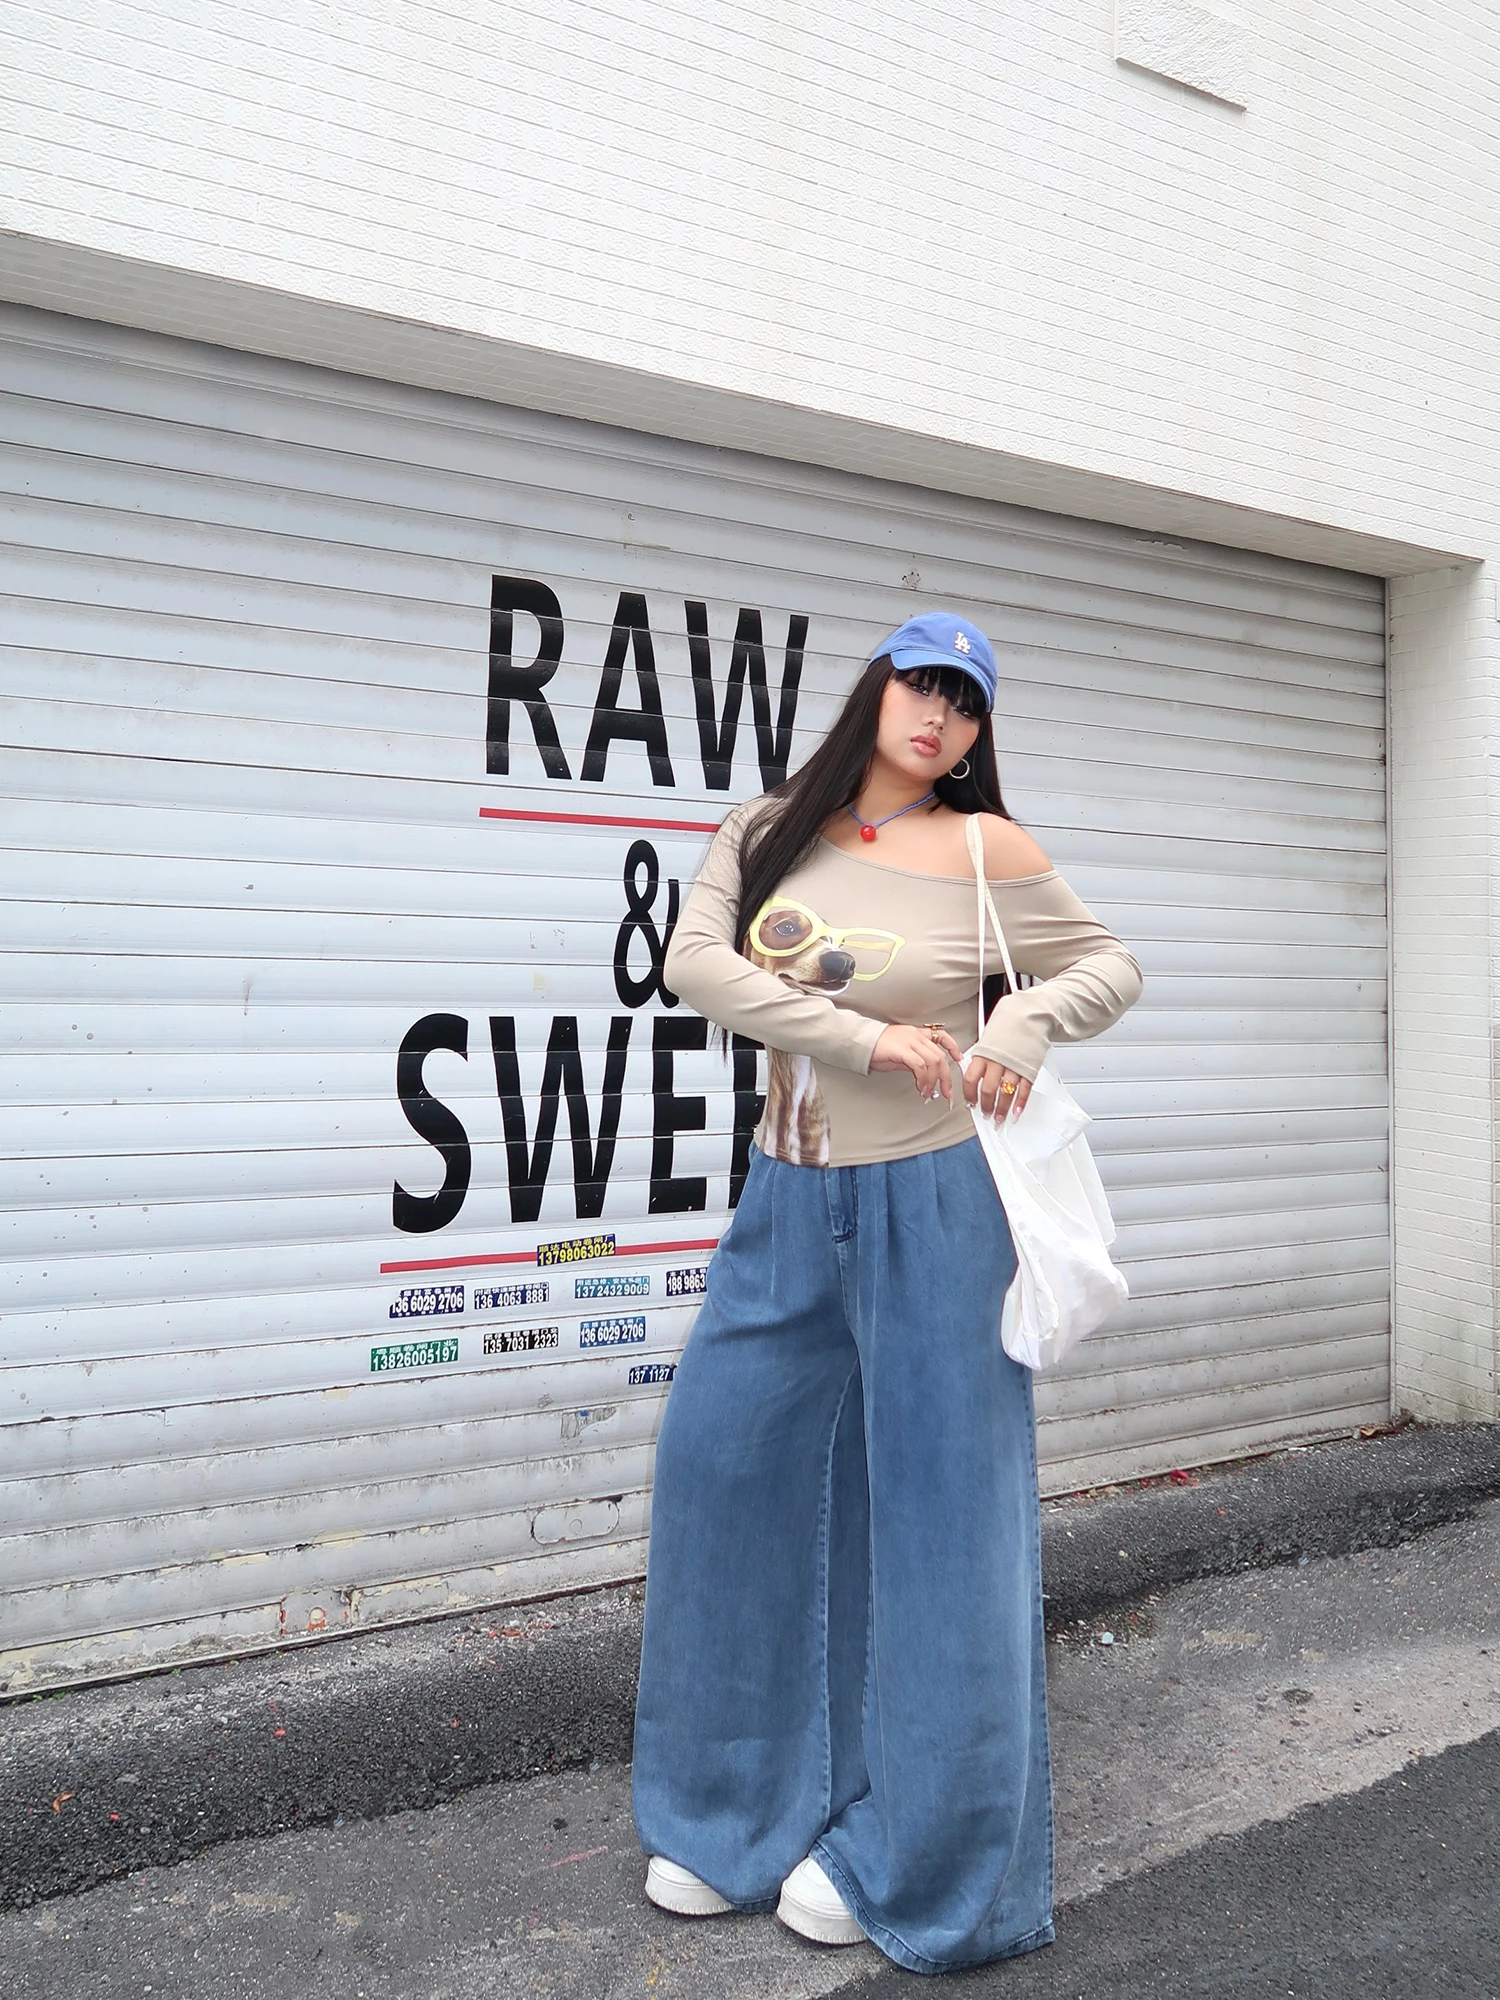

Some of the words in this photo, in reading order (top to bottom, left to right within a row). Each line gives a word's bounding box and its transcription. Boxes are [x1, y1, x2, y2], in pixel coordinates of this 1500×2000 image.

[954, 631, 971, 654] LA
[485, 574, 809, 794] RAW
[613, 839, 680, 1008] &
[539, 1241, 615, 1266] 13798063022
[667, 1275, 683, 1292] 188
[684, 1273, 706, 1290] 9863
[392, 1297, 409, 1314] 136
[410, 1294, 436, 1312] 6029
[438, 1292, 464, 1310] 2706
[475, 1294, 493, 1309] 136
[497, 1291, 522, 1307] 4063
[526, 1288, 550, 1304] 8881
[506, 1336, 529, 1352] 7031
[533, 1333, 558, 1348] 2323
[581, 1327, 596, 1344] 136
[597, 1325, 620, 1342] 6029
[621, 1322, 644, 1340] 2706
[373, 1345, 458, 1371] 13826005197
[630, 1370, 646, 1384] 137
[649, 1368, 670, 1382] 1127
